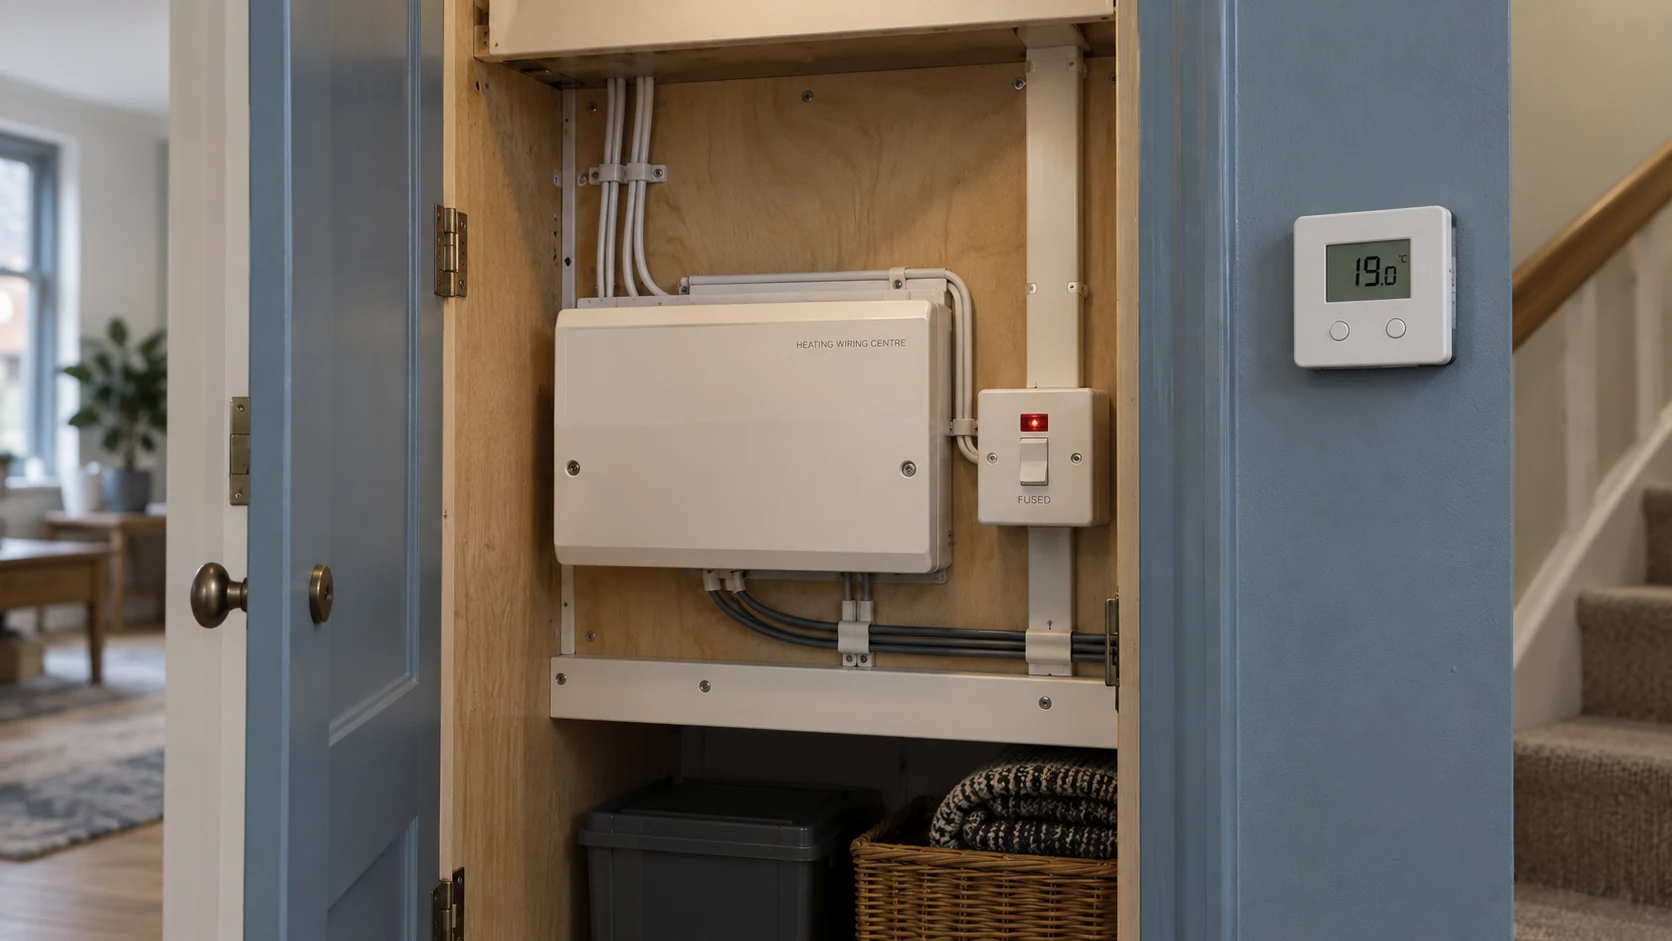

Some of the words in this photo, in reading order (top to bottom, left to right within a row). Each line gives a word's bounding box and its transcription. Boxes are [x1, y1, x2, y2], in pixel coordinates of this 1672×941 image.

[1355, 256, 1397, 287] 19.0
[796, 340, 834, 349] HEATING
[836, 339, 869, 348] WIRING
[870, 338, 906, 348] CENTRE
[1017, 495, 1052, 505] FUSED
